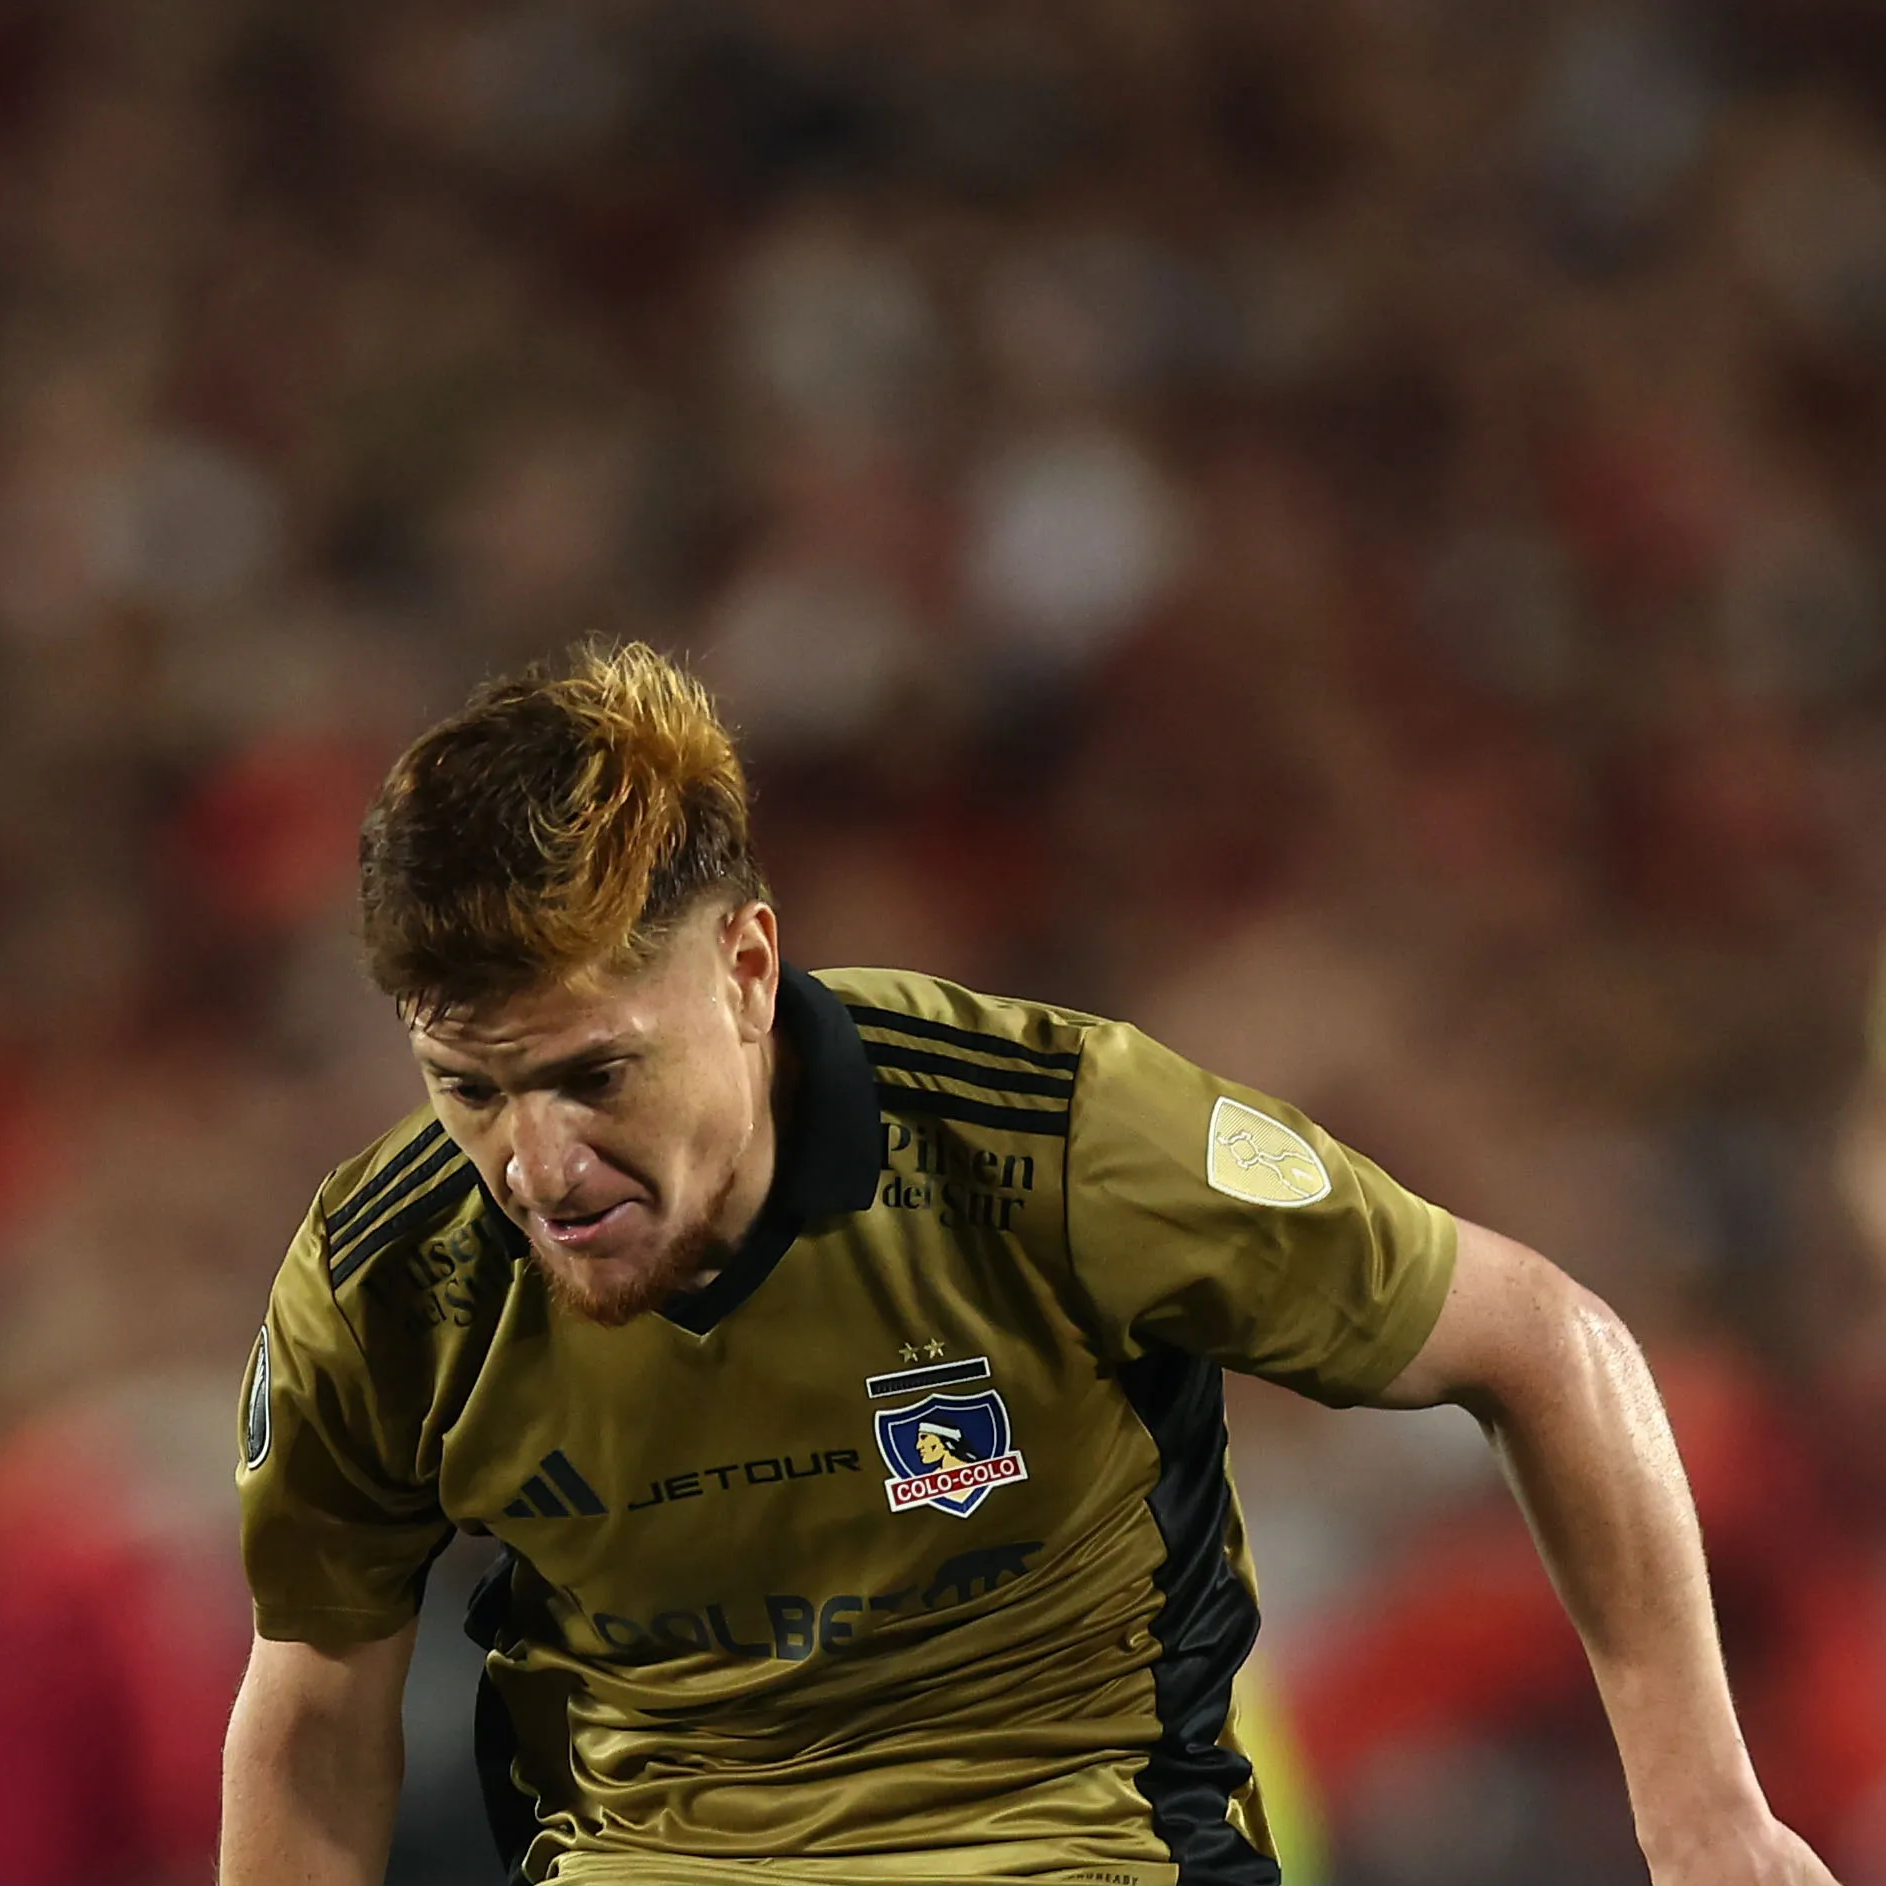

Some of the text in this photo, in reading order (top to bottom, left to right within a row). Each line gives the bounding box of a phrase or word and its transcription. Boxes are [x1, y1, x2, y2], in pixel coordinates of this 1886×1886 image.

[879, 1122, 1035, 1192] Pilen
[627, 1449, 863, 1510] JETOUR
[897, 1459, 1015, 1501] COLO-COLO
